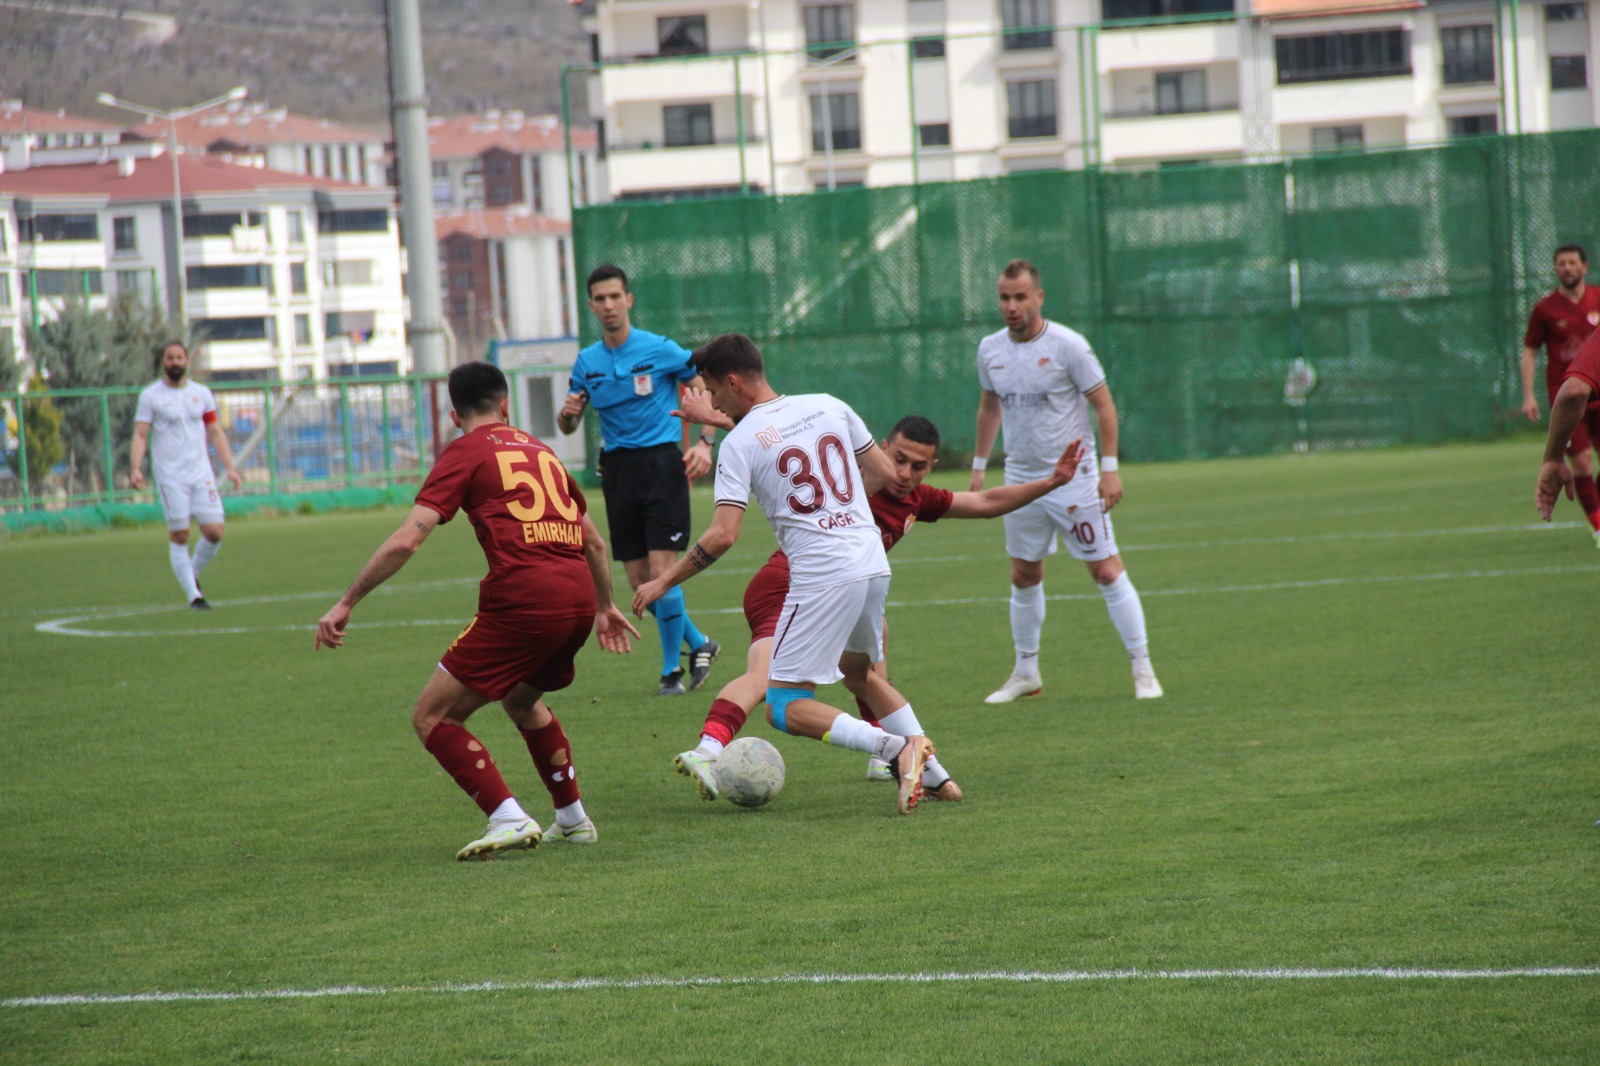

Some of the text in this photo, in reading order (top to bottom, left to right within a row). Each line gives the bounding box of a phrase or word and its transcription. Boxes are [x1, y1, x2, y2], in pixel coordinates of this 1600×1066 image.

[495, 450, 578, 522] 50
[776, 431, 855, 516] 30
[1071, 521, 1096, 545] 10
